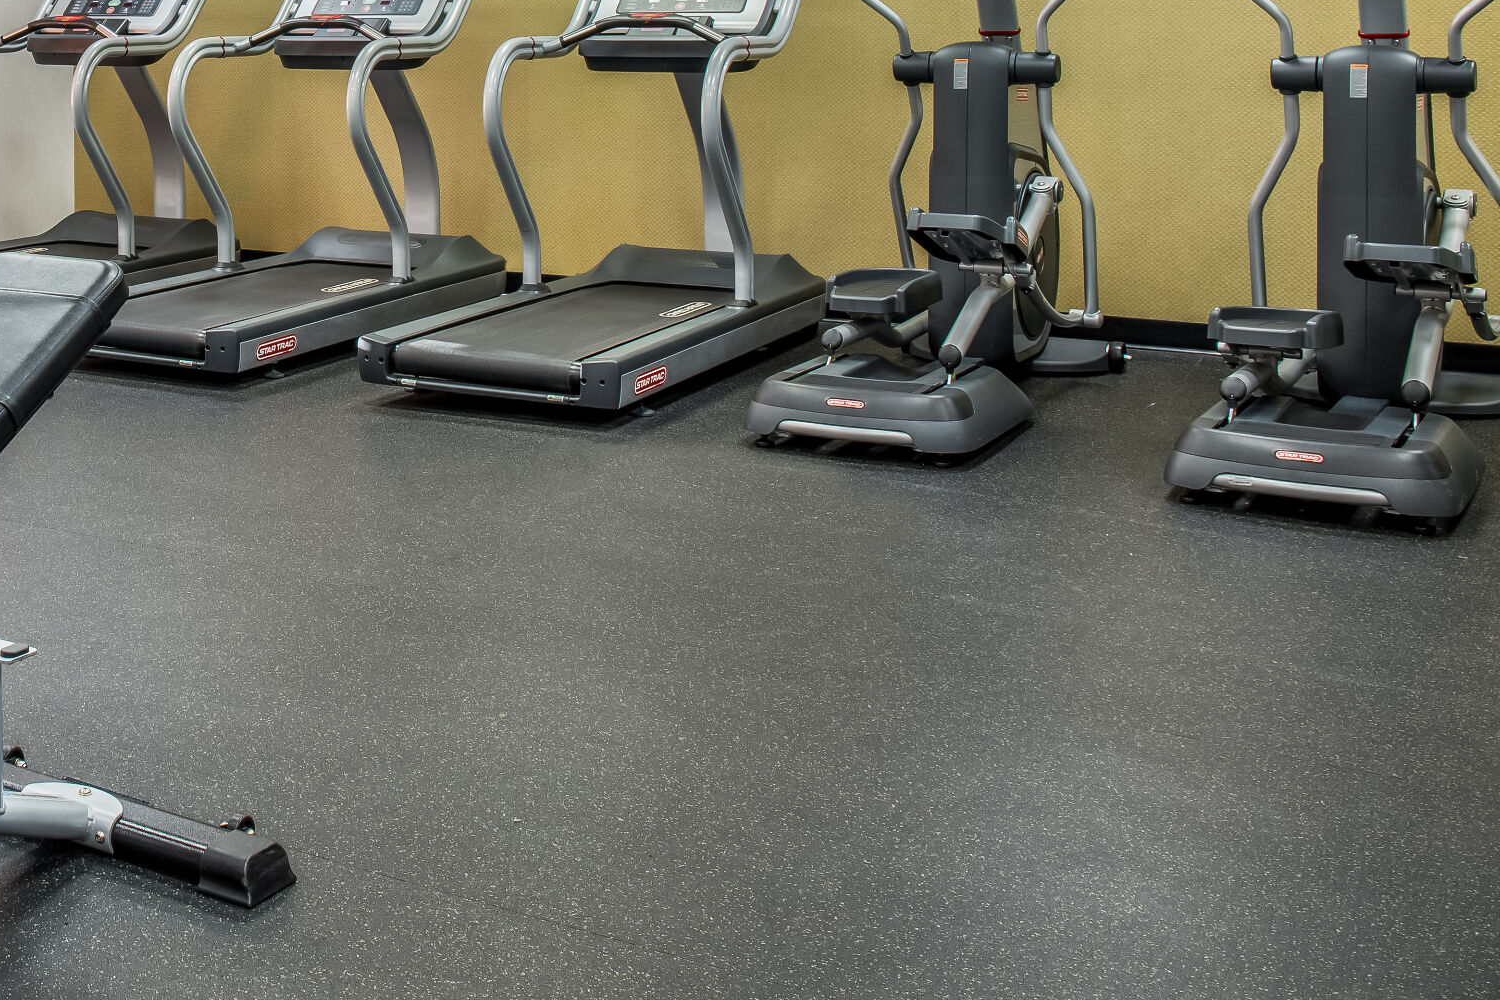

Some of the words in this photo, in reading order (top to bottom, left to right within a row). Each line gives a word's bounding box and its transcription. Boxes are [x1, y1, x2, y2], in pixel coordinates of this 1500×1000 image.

[259, 345, 277, 355] STAR
[277, 340, 294, 351] TRAC
[636, 377, 650, 389] STAR
[650, 372, 665, 384] TRAC
